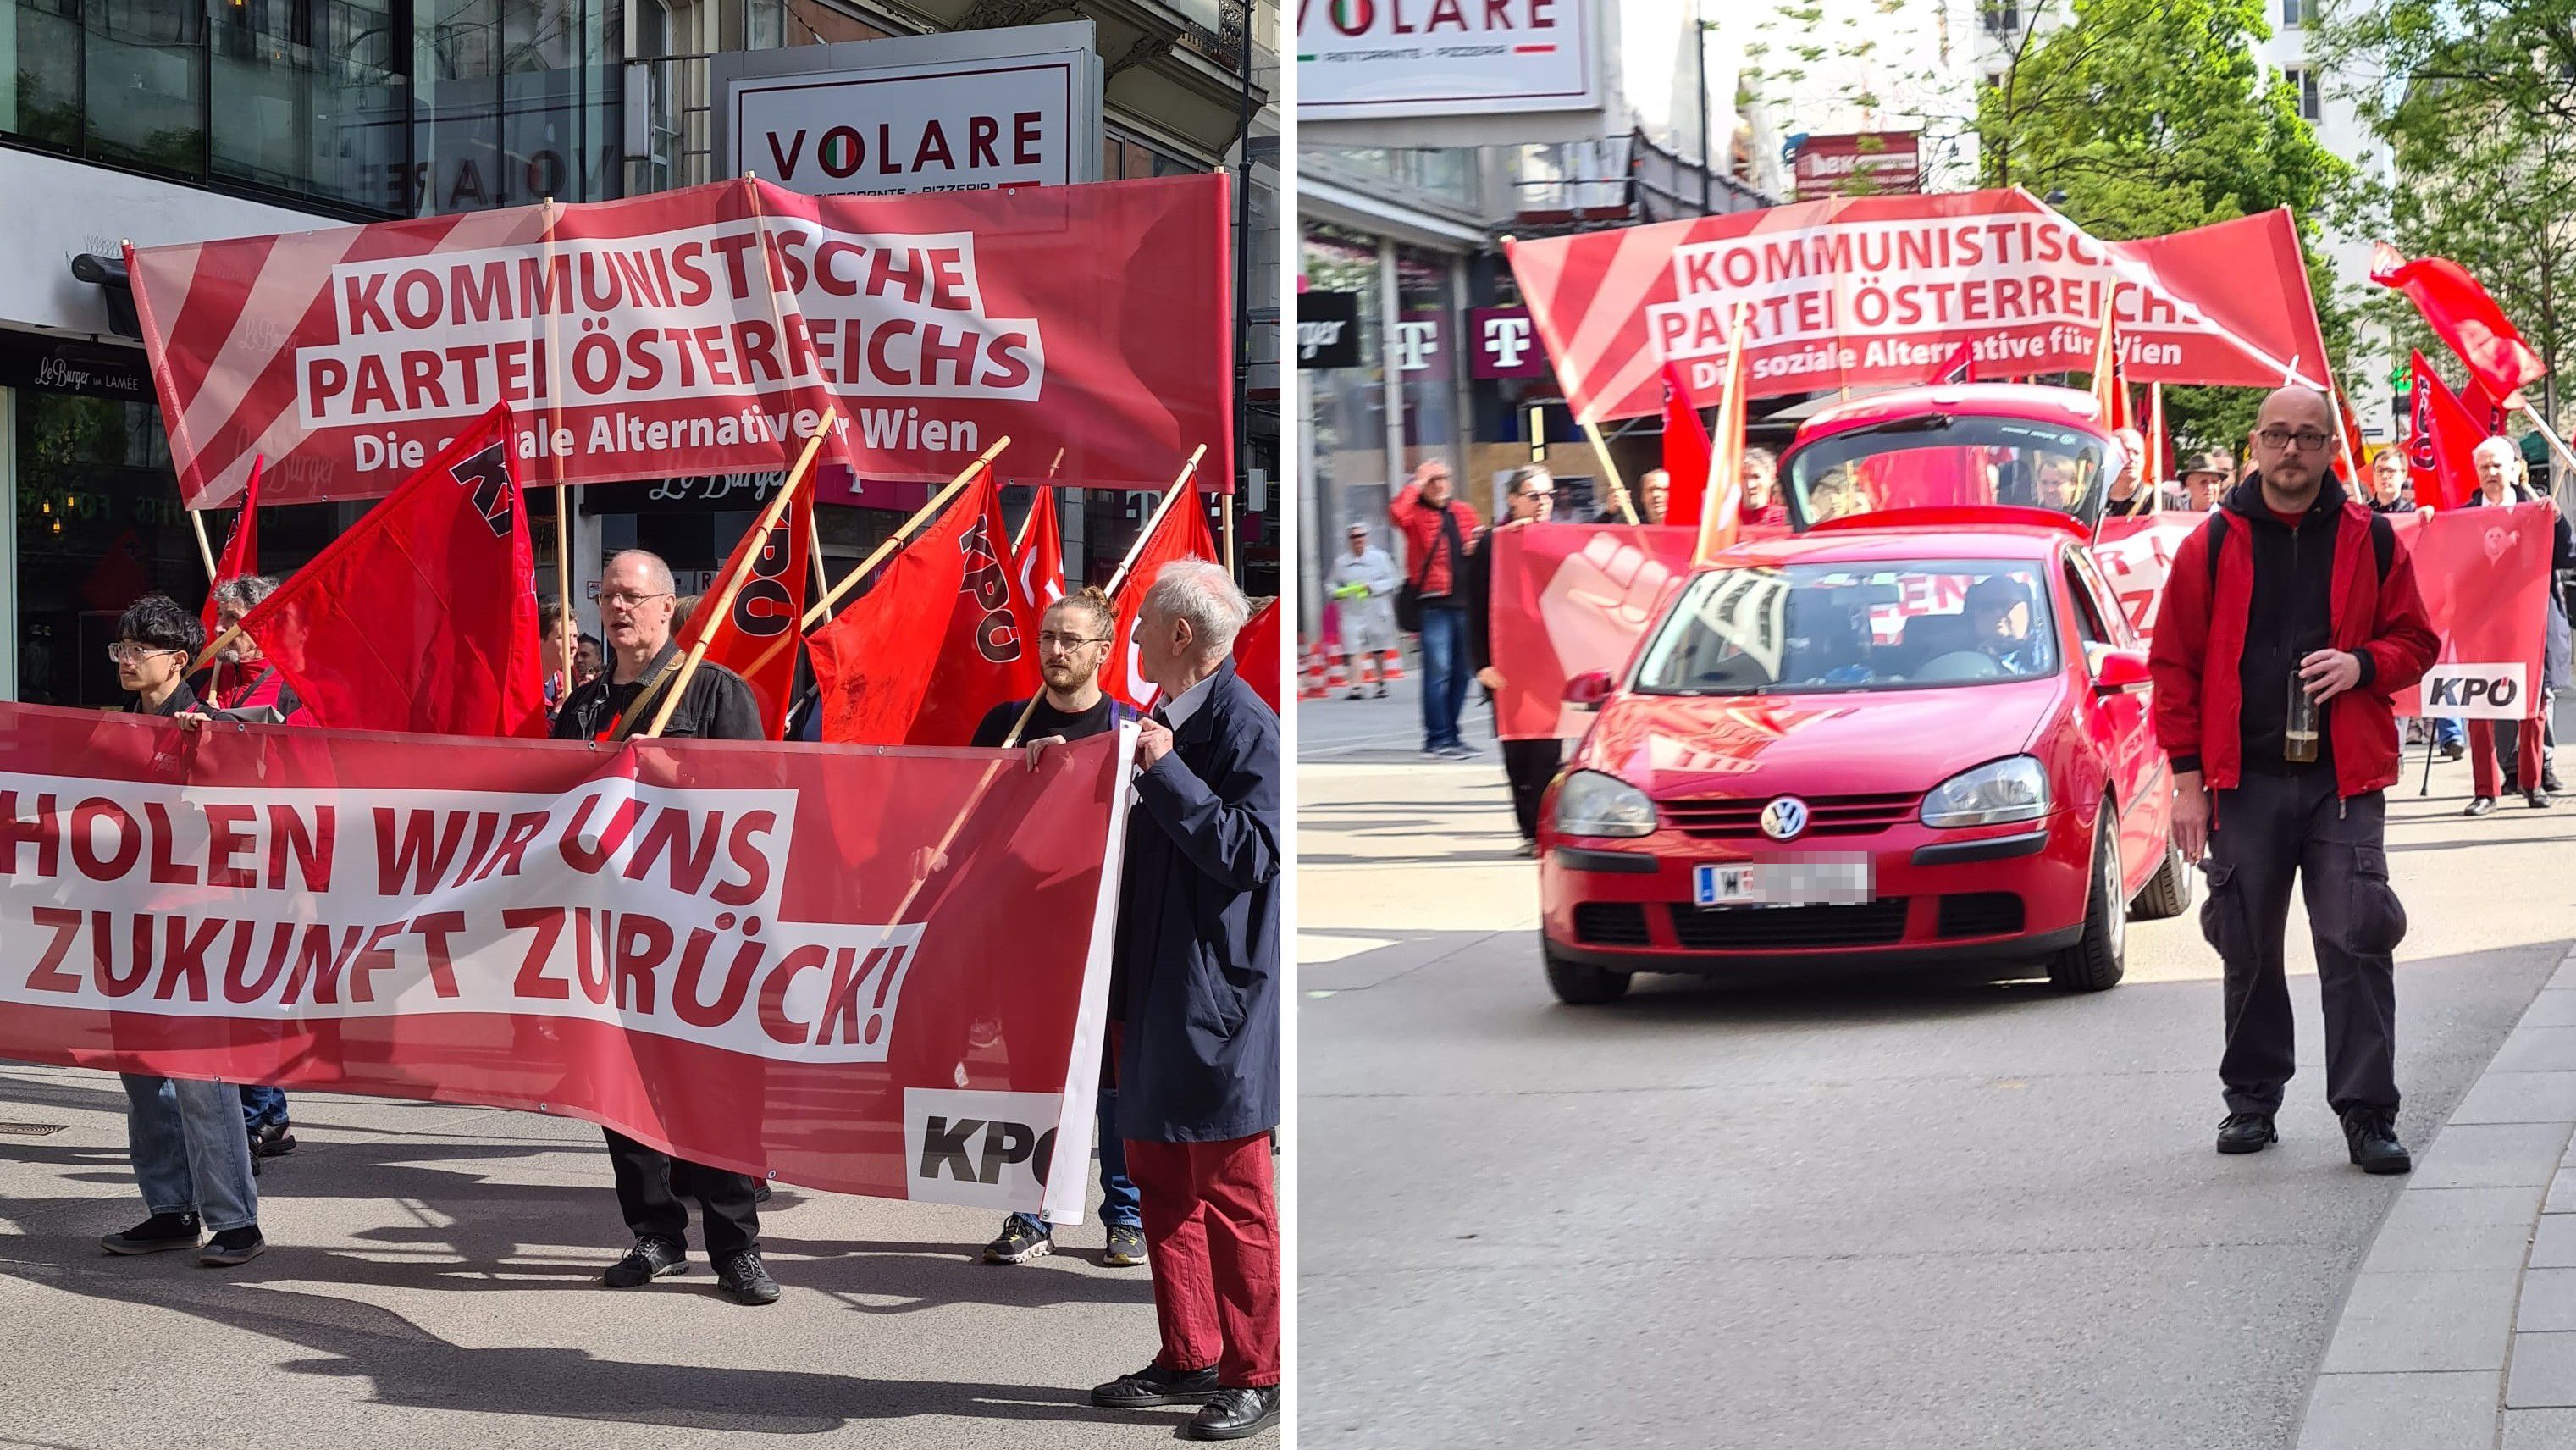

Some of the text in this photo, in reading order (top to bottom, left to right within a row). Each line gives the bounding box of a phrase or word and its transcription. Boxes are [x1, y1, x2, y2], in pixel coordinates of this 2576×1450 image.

[1297, 0, 1556, 36] OLARE
[766, 111, 1042, 182] VOLARE
[345, 230, 973, 335] KOMMUNISTISCHE
[53, 358, 91, 390] Burger
[308, 312, 1031, 418] PARTEI ÖSTERREICHS
[1692, 360, 1729, 390] Di
[1752, 342, 1857, 380] soziale
[2049, 325, 2095, 356] für
[354, 432, 424, 471] Die
[587, 404, 821, 455] Alternative
[860, 407, 978, 451] Wien
[2429, 676, 2518, 707] KPÖ
[0, 789, 777, 907] HOLEN WIR UNS
[25, 905, 909, 1047] ZUKUNFT ZURÜCK!
